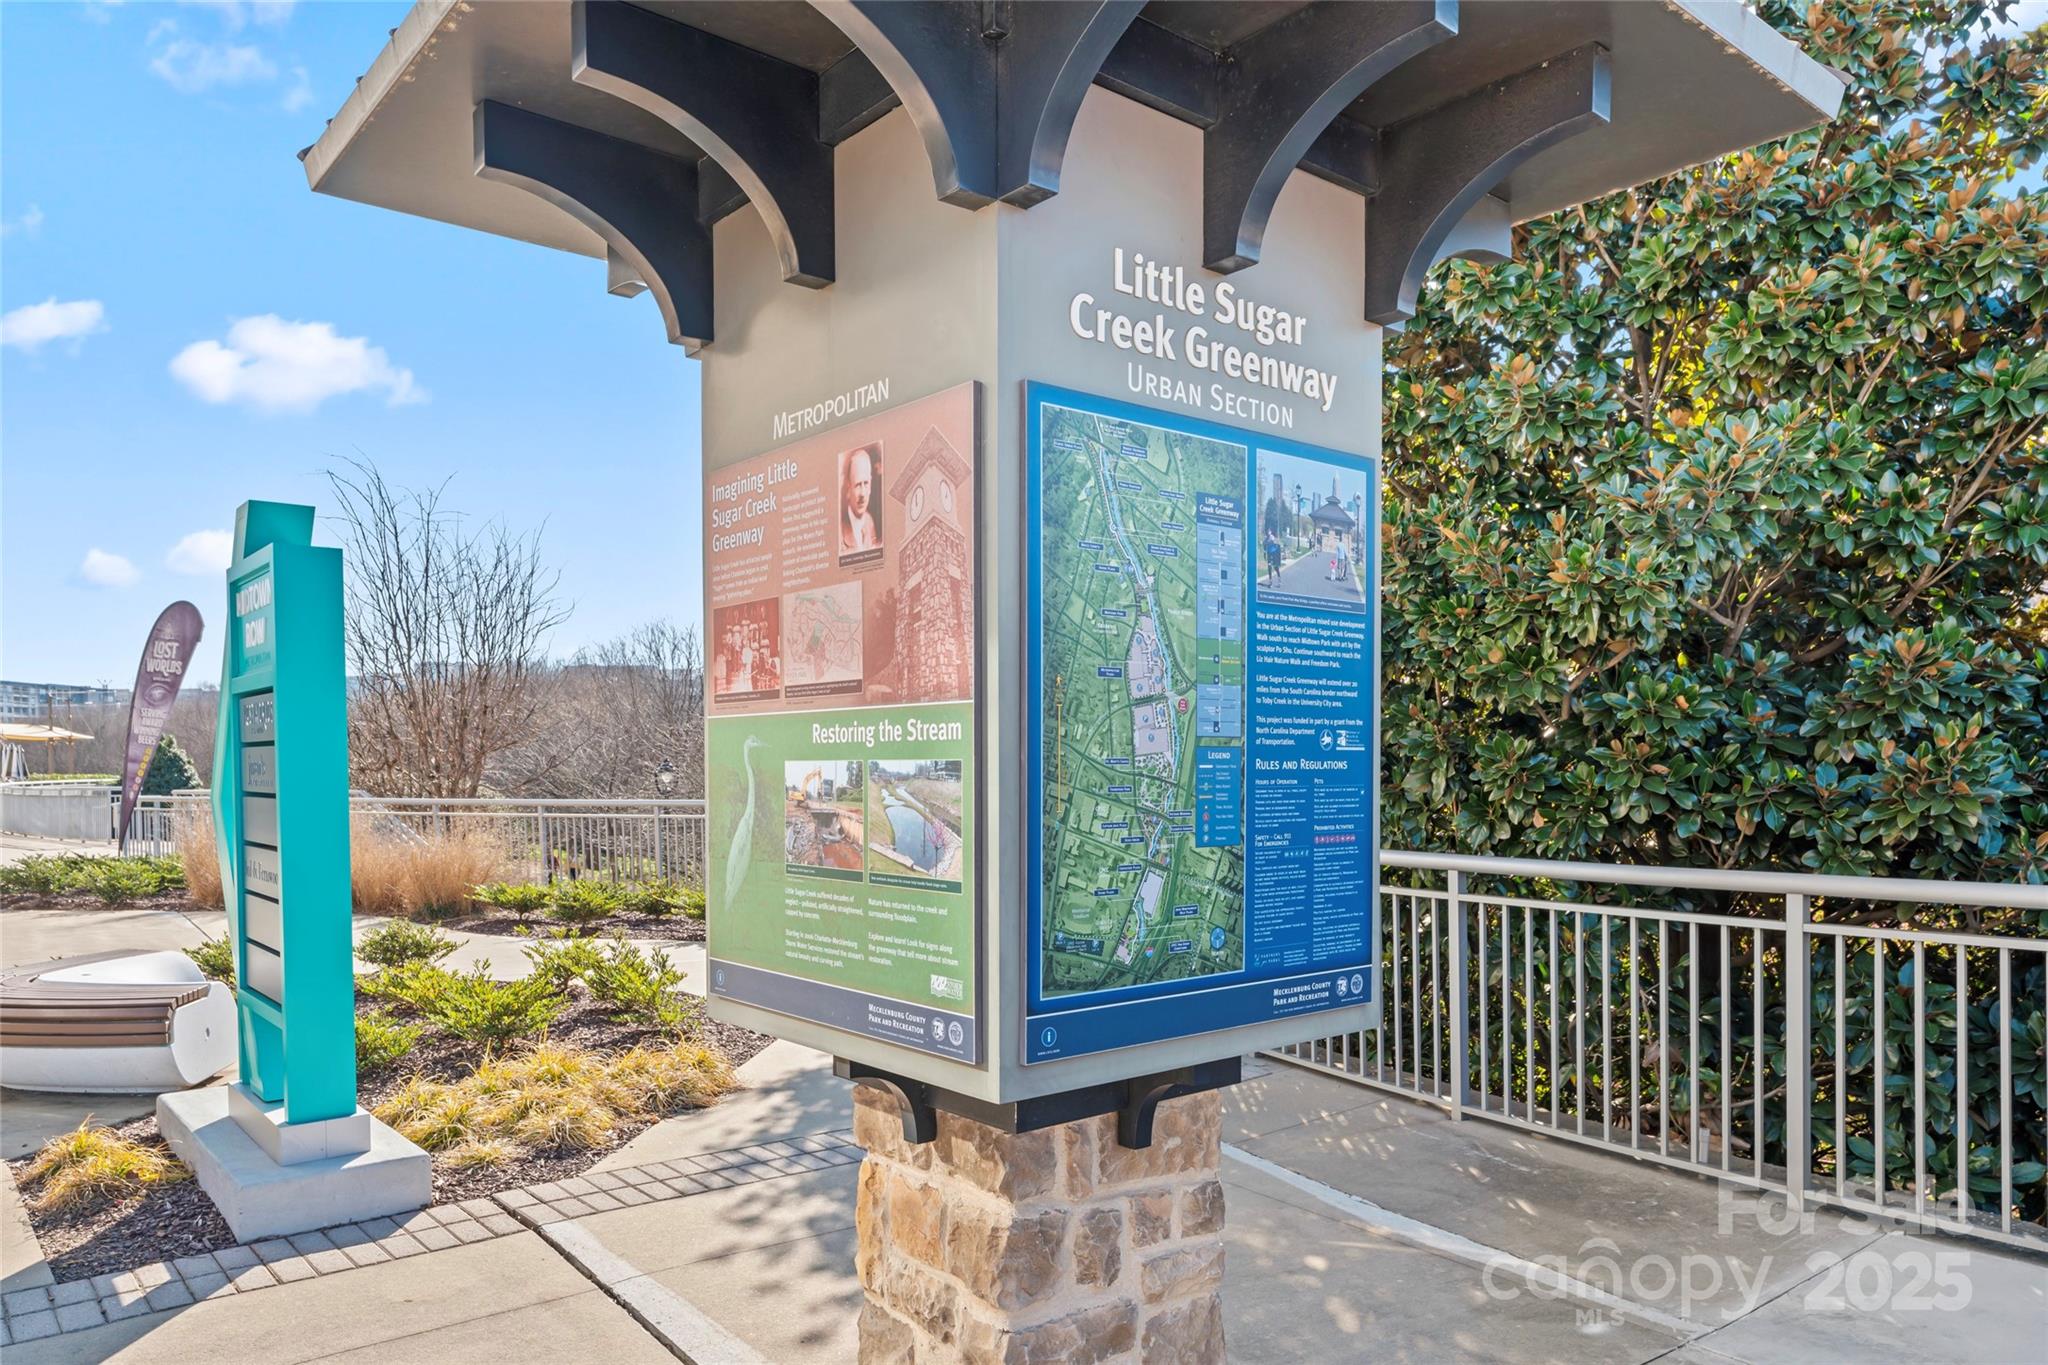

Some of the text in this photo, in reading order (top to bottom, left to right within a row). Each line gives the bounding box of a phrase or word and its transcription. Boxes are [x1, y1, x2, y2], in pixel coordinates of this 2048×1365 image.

[1114, 247, 1306, 346] Little Sugar
[1070, 292, 1338, 412] Creek Greenway
[1128, 362, 1293, 428] URBAN SECTION
[774, 377, 889, 440] METROPOLITAN
[712, 459, 798, 502] Imagining Little
[712, 492, 776, 528] Sugar Creek
[1200, 504, 1239, 519] Creek Greenway
[1205, 497, 1233, 509] Little Sugar
[712, 526, 764, 552] Greenway
[246, 617, 266, 648] ROW
[153, 641, 179, 659] LOST
[146, 658, 183, 676] WORLDS
[812, 718, 962, 747] Restoring the Stream
[1256, 758, 1347, 769] RULES AND REGULATIONS
[1273, 982, 1331, 996] MECKLENBURG COUNTY
[1274, 997, 1287, 1006] PARK
[1299, 991, 1329, 1002] RECREATION
[869, 1003, 926, 1024] MECKLENBURG COUNTY
[869, 1014, 881, 1024] PARK
[893, 1020, 924, 1034] RECREATION
